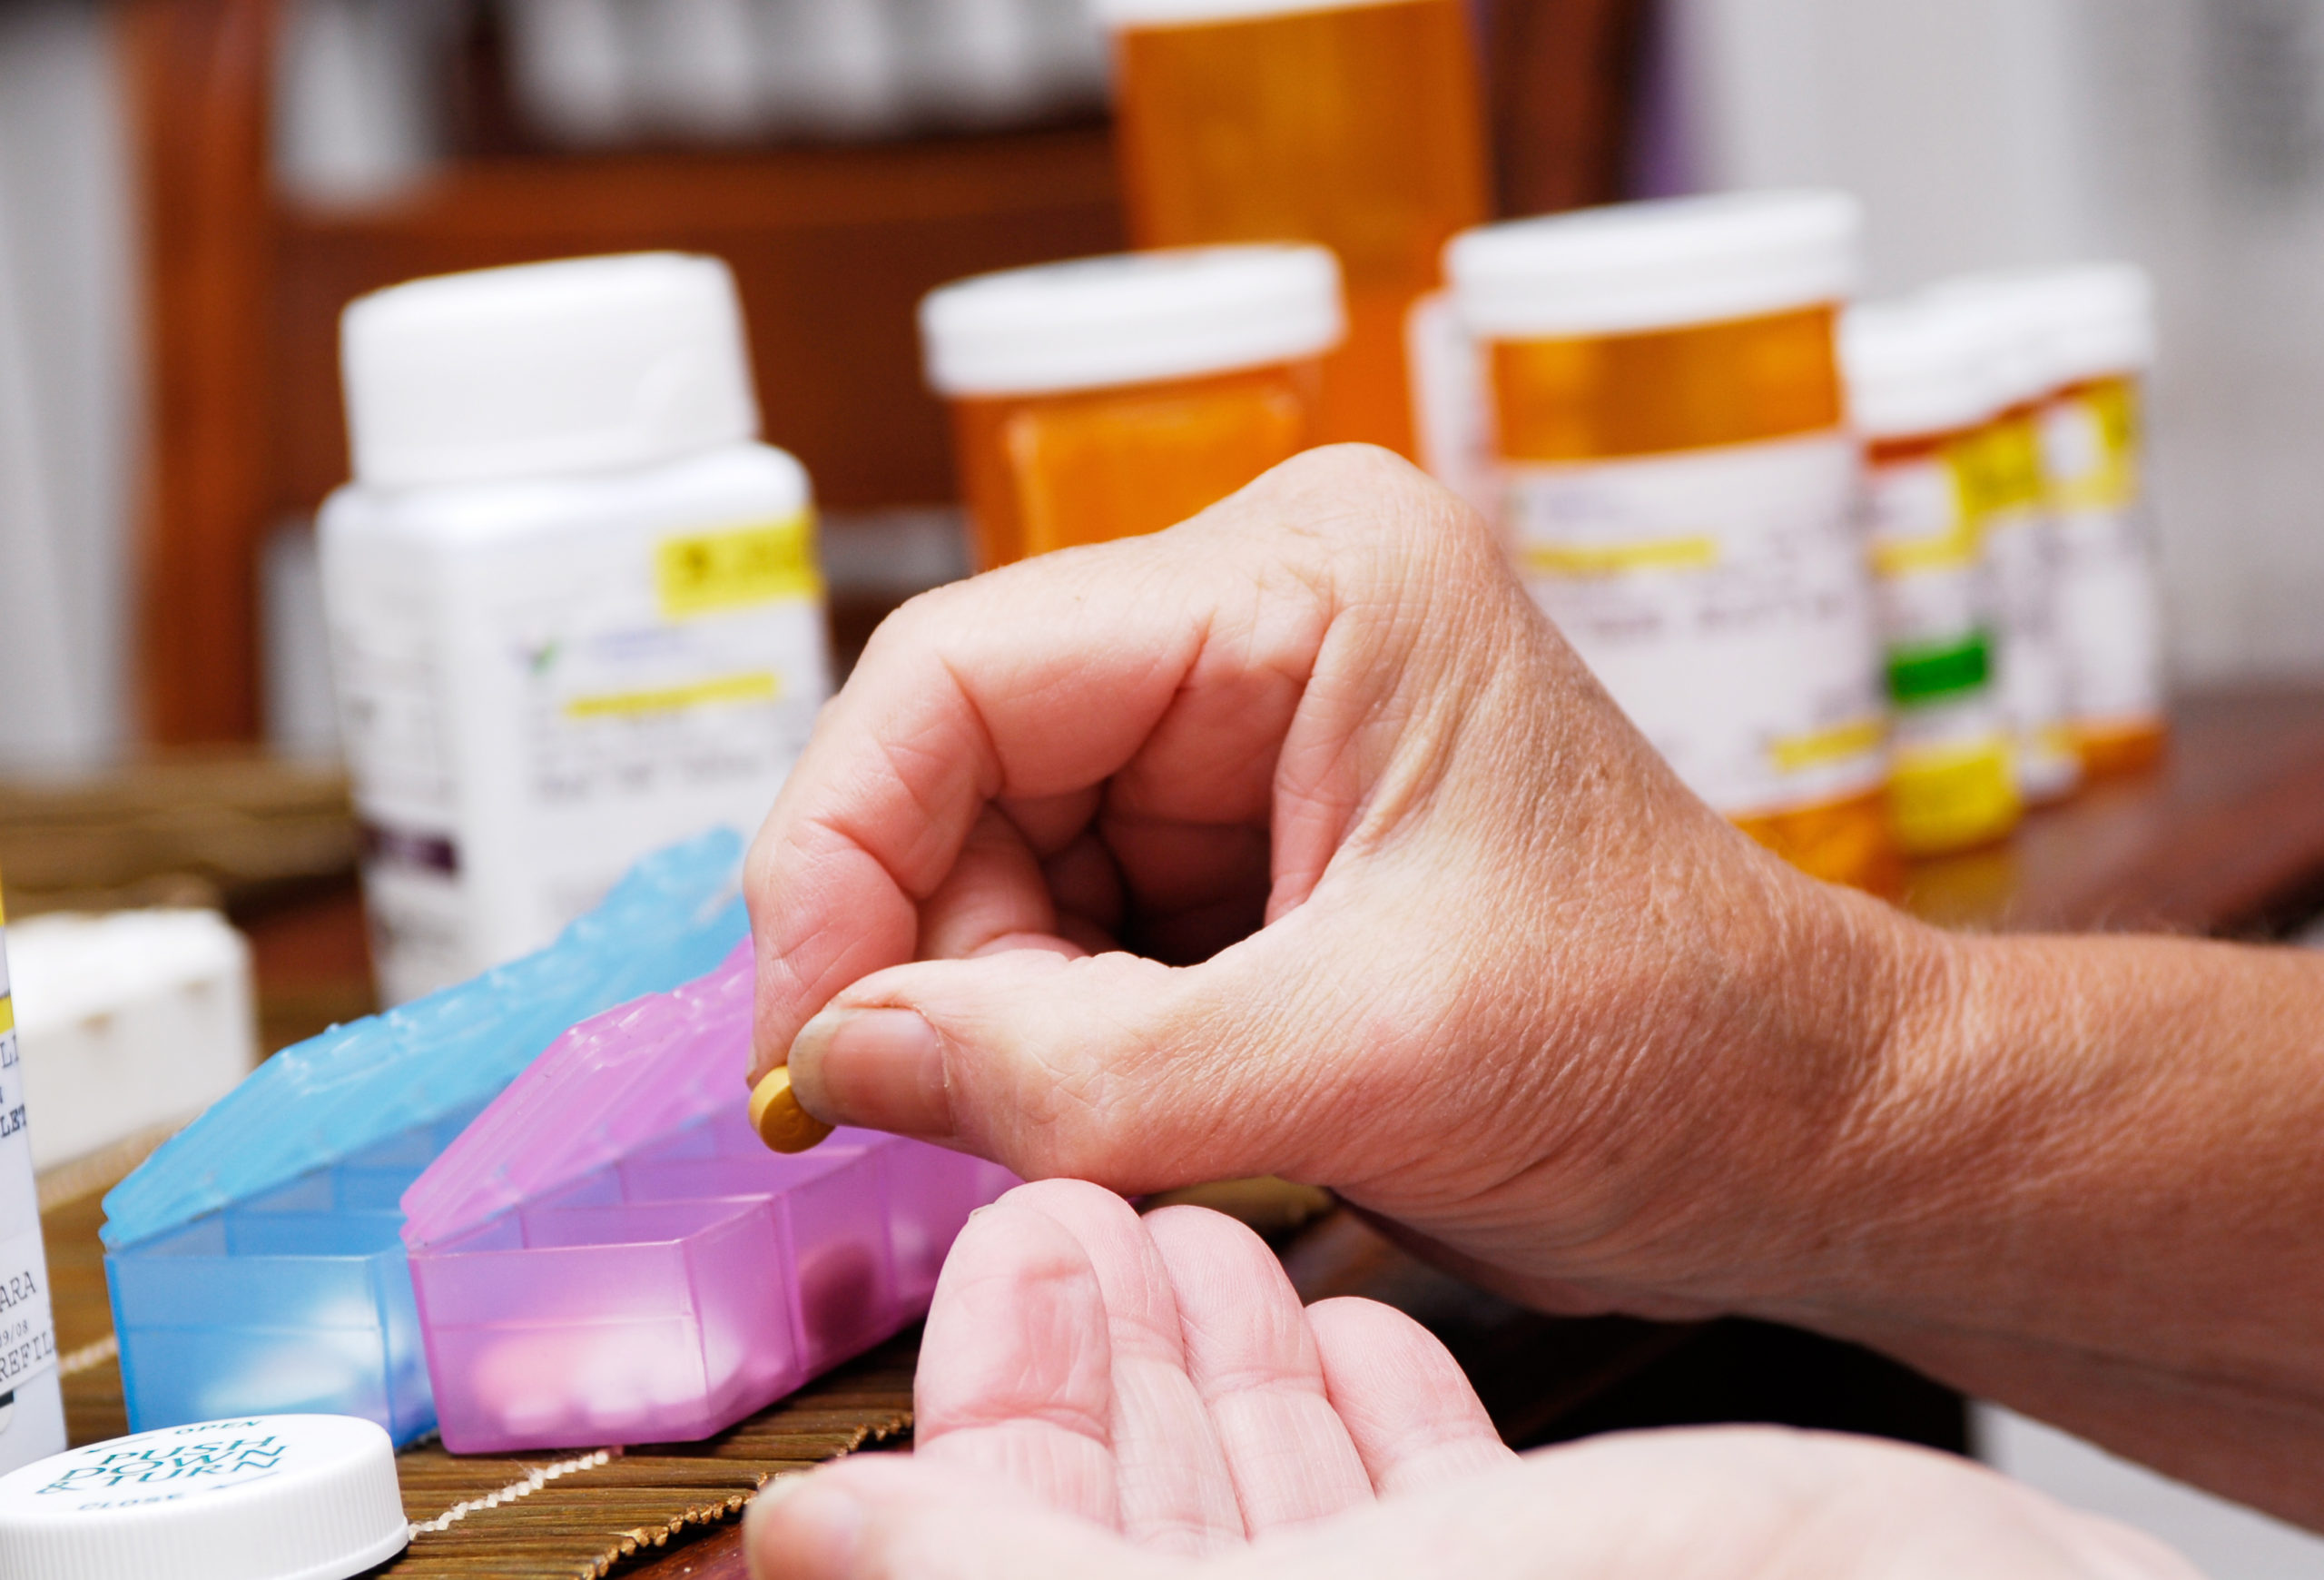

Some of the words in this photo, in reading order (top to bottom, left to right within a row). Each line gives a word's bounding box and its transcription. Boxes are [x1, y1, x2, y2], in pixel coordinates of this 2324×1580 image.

[175, 1420, 262, 1435] OPEN
[59, 1446, 289, 1481] DOWN
[99, 1436, 279, 1466] PUSH
[34, 1481, 86, 1495] &
[102, 1457, 282, 1487] TURN
[77, 1493, 184, 1511] CLOSE
